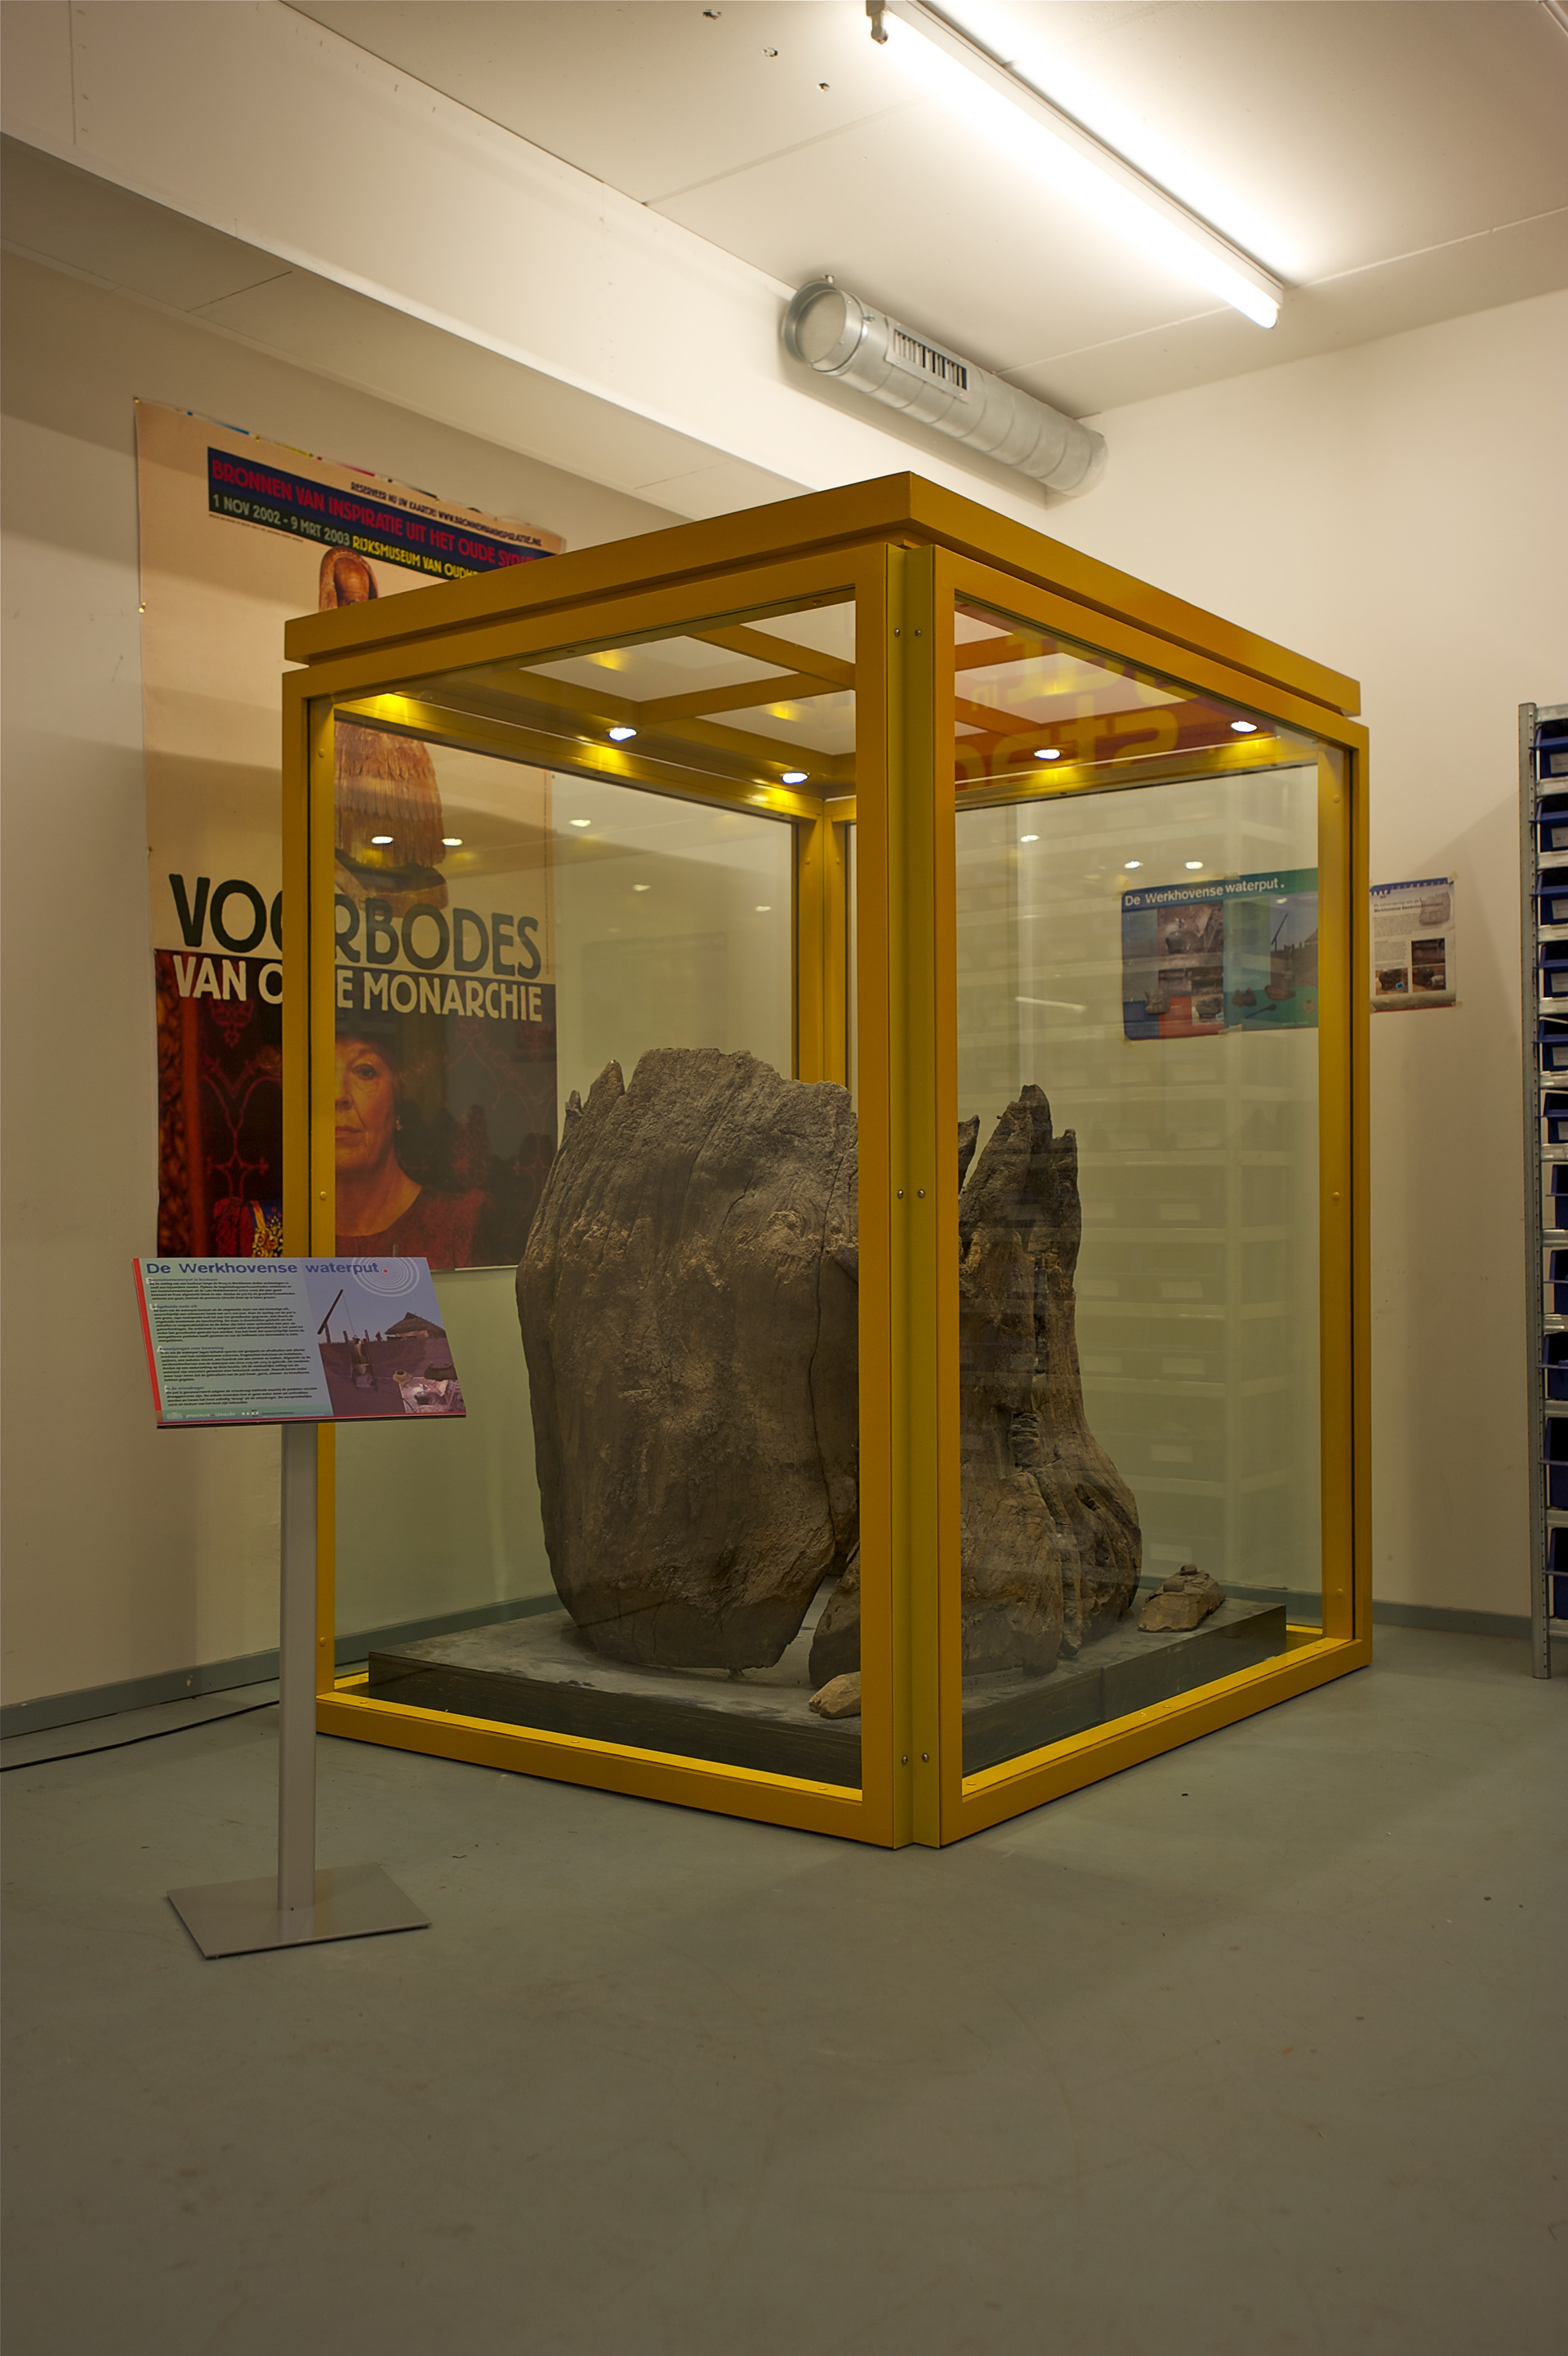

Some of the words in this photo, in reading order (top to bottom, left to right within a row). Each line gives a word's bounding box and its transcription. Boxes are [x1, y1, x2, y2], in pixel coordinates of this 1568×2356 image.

[212, 459, 292, 501] BRONNEN
[296, 485, 325, 512] VAN
[328, 496, 403, 537] INSPIRATIE
[406, 521, 426, 542] UIT
[430, 528, 455, 551] HET
[457, 538, 495, 564] OUDE
[350, 482, 387, 501] RESERVEER
[388, 494, 398, 505] NU
[399, 497, 408, 507] UW
[213, 493, 220, 508] 1
[223, 496, 250, 516] NOV
[252, 505, 282, 525] 2002
[291, 516, 297, 530] 9
[300, 519, 322, 538] MRT
[324, 527, 350, 546] 2003
[352, 535, 421, 568] RIJKSMUSEUM
[422, 556, 443, 573] VAN
[168, 873, 541, 979] VORBODES
[1125, 895, 1141, 906] De
[1145, 886, 1223, 904] Werkhovense
[173, 955, 247, 1001] VAN
[363, 971, 542, 1022] MONARCHIE
[146, 1263, 172, 1274] De
[179, 1262, 298, 1274] Werkhovense
